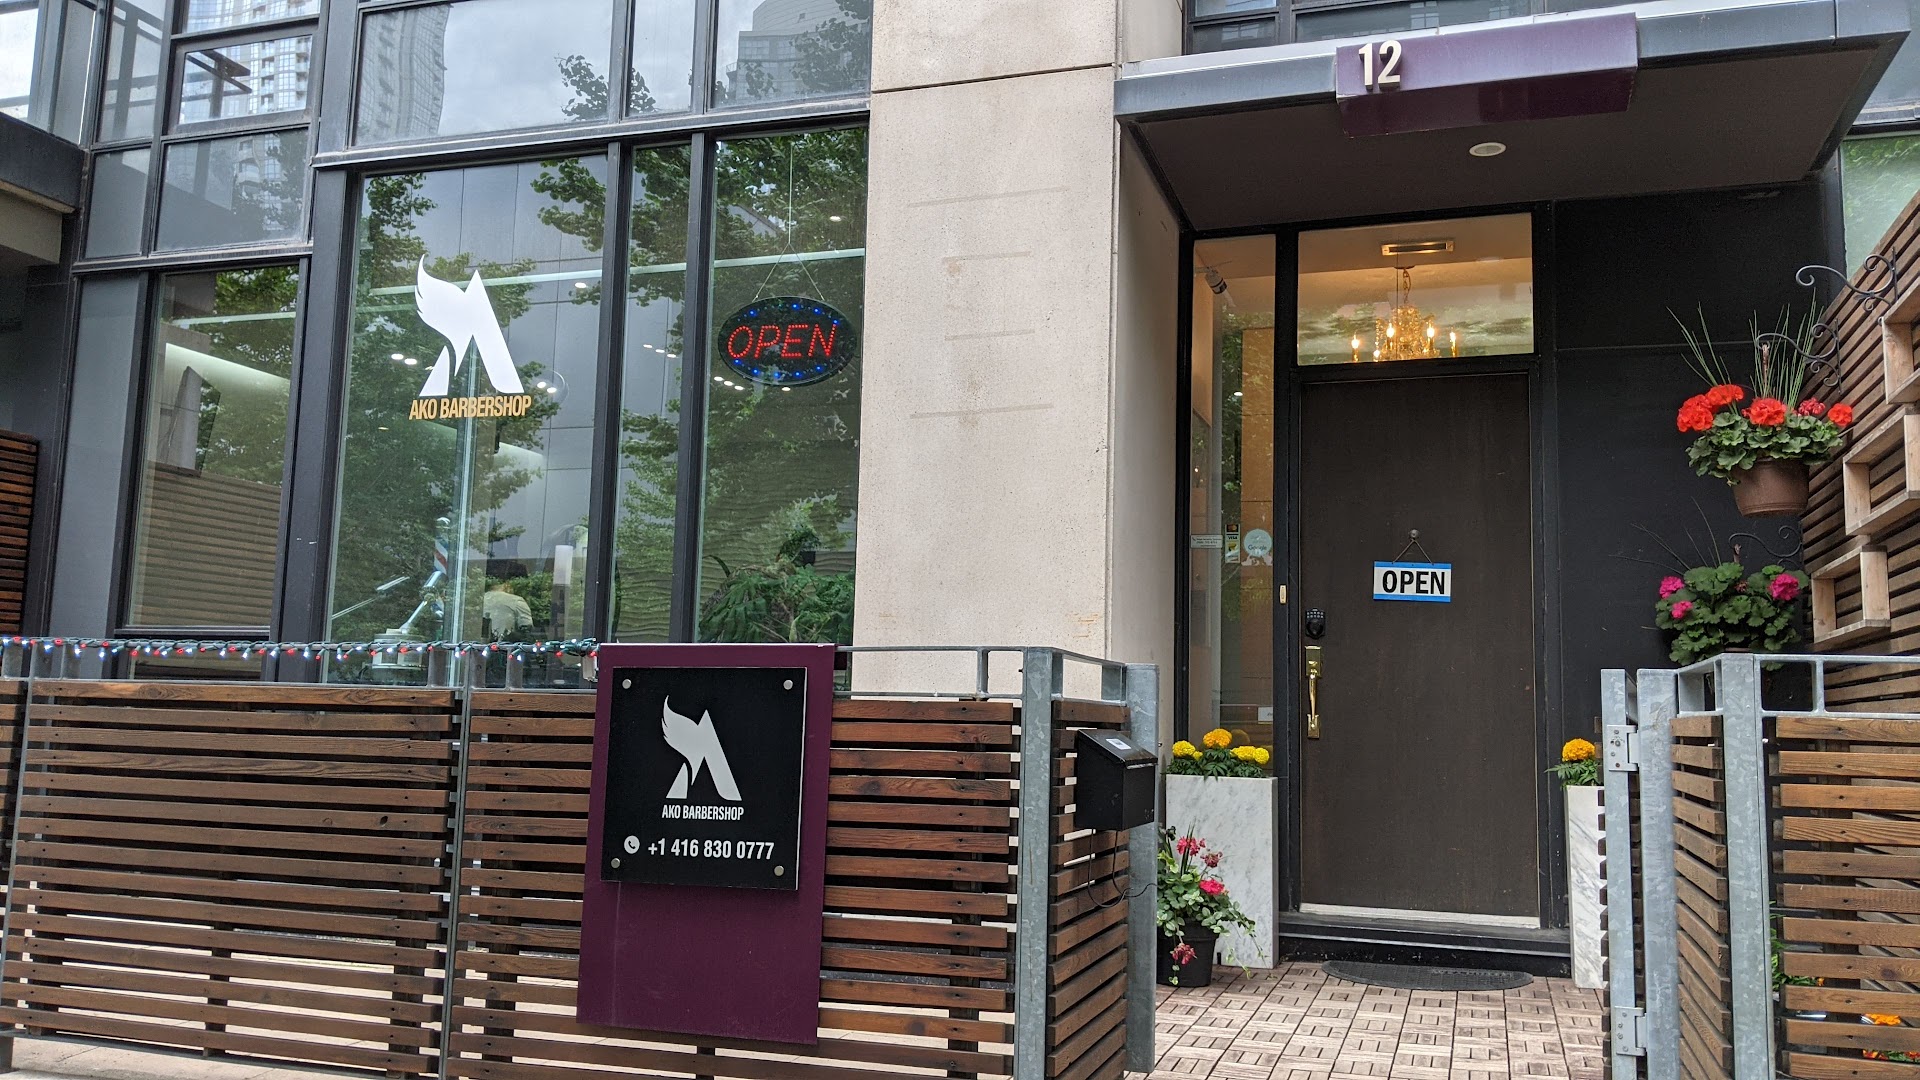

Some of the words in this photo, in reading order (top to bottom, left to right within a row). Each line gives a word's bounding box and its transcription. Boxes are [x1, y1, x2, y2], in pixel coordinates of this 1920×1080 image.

[1358, 40, 1402, 87] 12
[727, 323, 838, 359] OPEN
[408, 398, 438, 421] AKO
[440, 395, 532, 419] BARBERSHOP
[1382, 570, 1446, 595] OPEN
[661, 804, 681, 819] AKO
[682, 804, 745, 821] BARBERSHOP
[647, 837, 666, 856] +1
[670, 838, 699, 857] 416
[703, 839, 732, 858] 830
[736, 840, 775, 860] 0777
